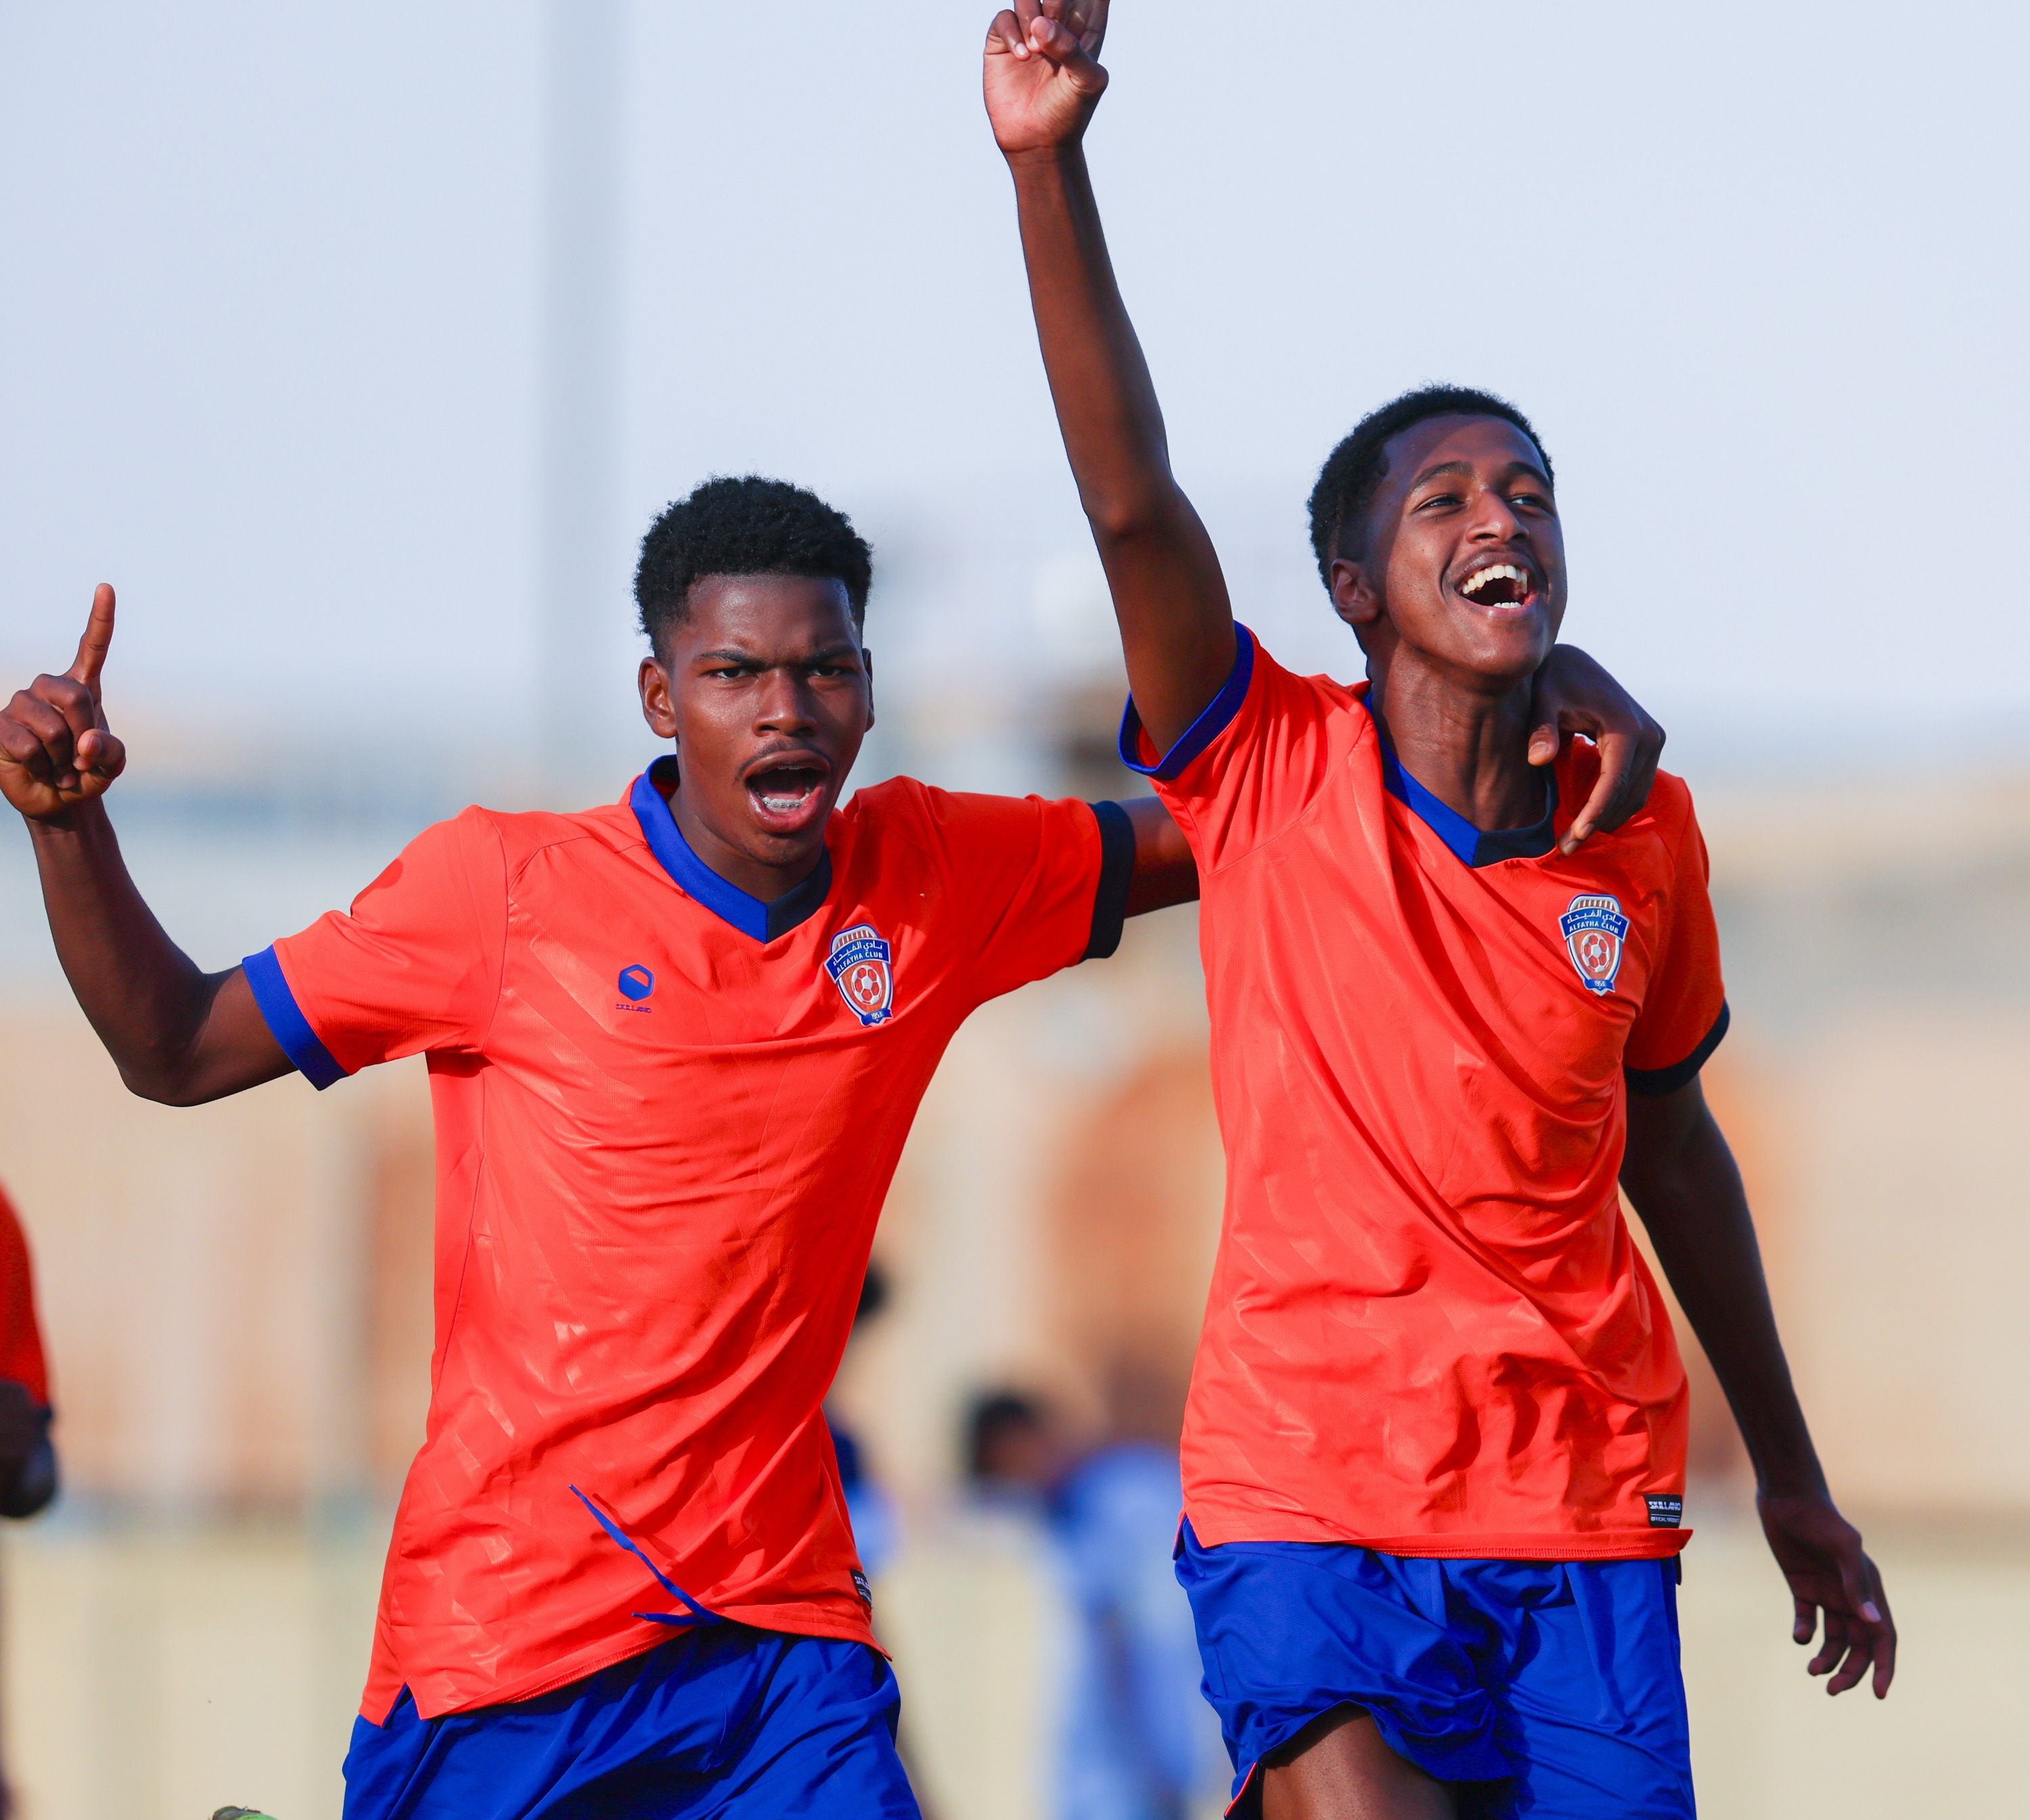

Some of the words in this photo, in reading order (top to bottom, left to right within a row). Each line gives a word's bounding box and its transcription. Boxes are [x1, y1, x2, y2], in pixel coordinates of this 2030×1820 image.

[1567, 909, 1602, 924] الفيحاء
[1602, 914, 1622, 925] نادي
[1569, 921, 1599, 932] ALFAYHA
[1602, 922, 1619, 934] CLUB
[863, 940, 882, 951] نادي
[833, 941, 861, 966] الفيحاء
[836, 953, 863, 974] ALFAYHA
[872, 1011, 882, 1020] 1953
[1648, 1501, 1681, 1511] SKILLANO
